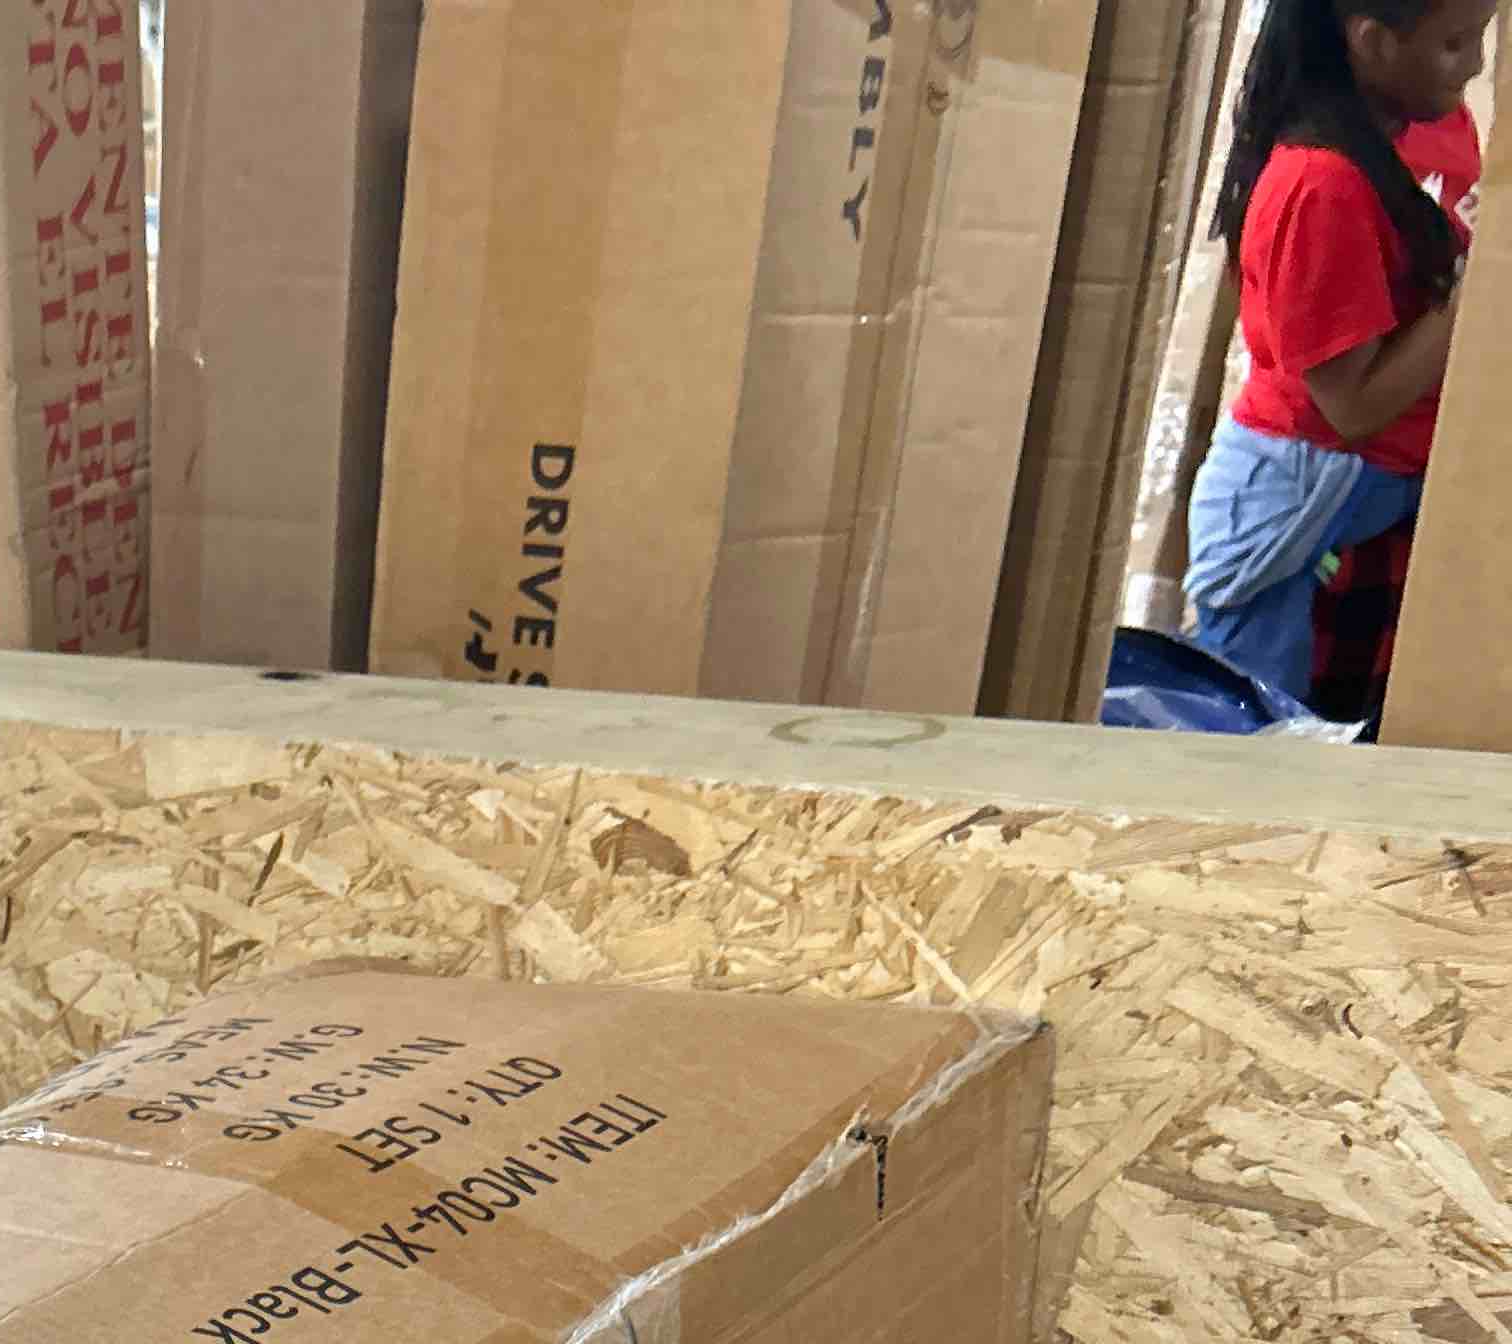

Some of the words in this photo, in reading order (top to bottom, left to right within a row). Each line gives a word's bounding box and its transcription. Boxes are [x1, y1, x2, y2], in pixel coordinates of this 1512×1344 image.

[512, 444, 576, 648] DRIVE
[223, 1108, 314, 1142] KG
[336, 1115, 442, 1173] SET
